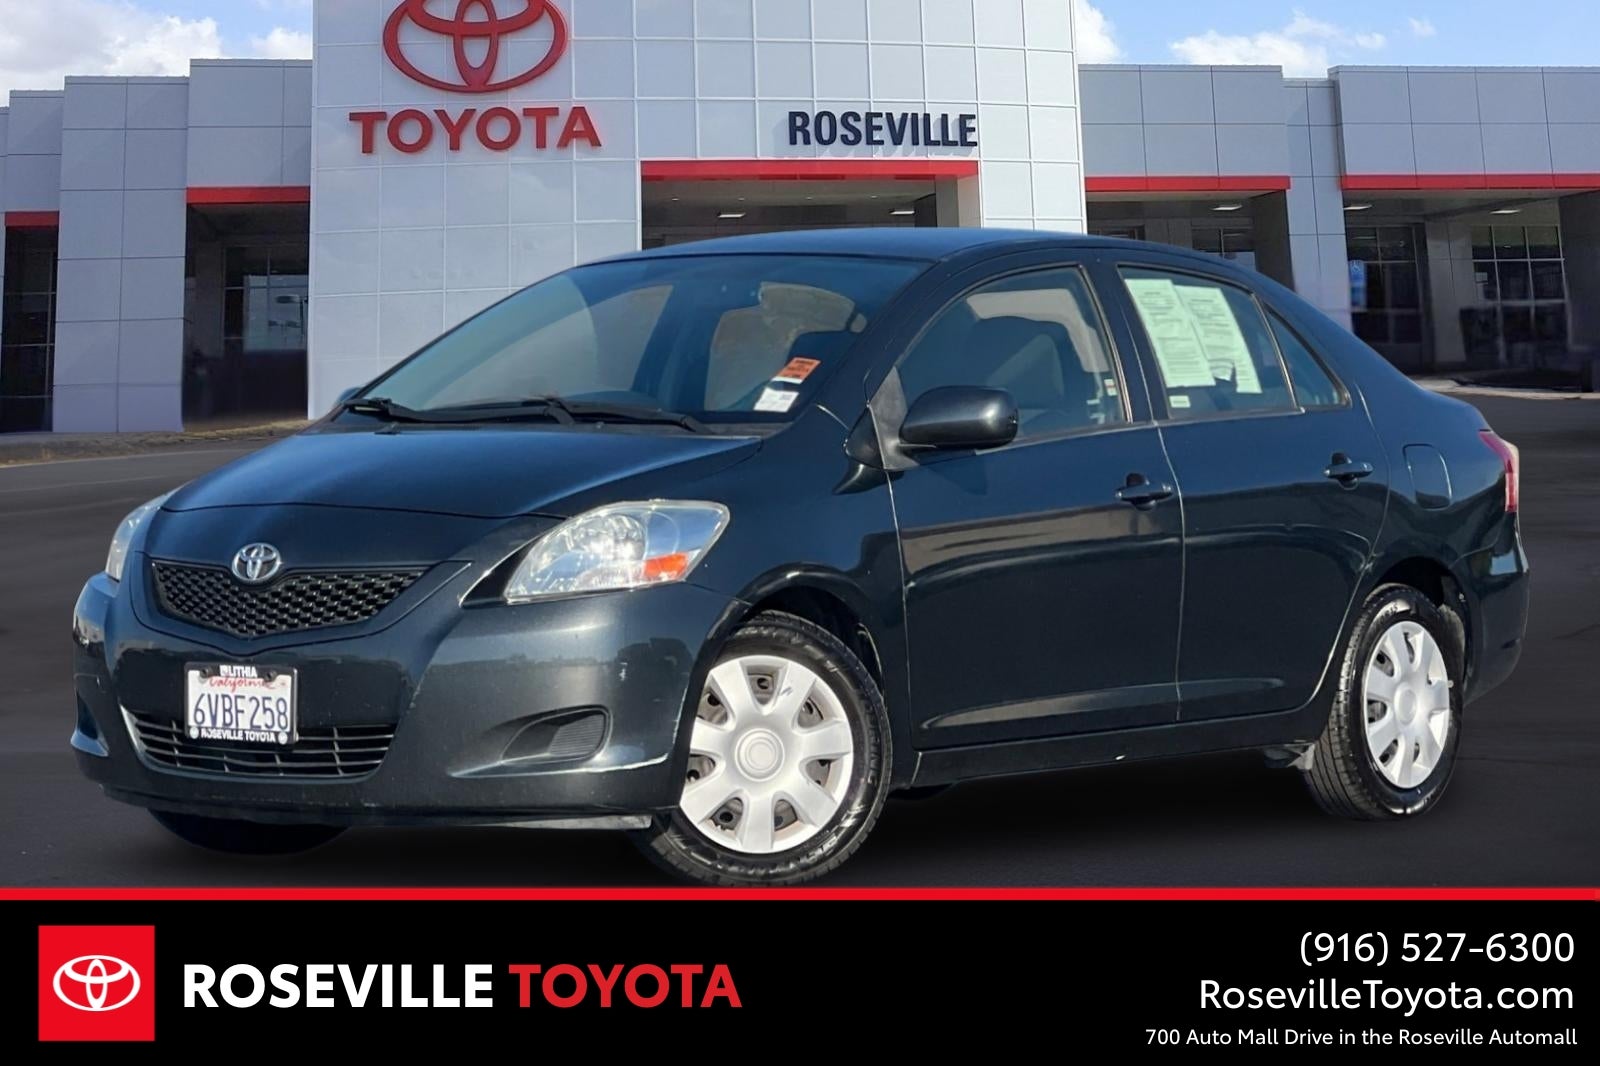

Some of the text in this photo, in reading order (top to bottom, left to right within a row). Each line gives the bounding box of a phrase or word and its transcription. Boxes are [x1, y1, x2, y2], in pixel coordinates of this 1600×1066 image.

[349, 106, 602, 154] TOYOTA
[788, 110, 978, 147] ROSEVILLE
[228, 665, 258, 678] LITHIA
[194, 693, 289, 731] 6VBF258
[245, 731, 276, 743] TOYOTA
